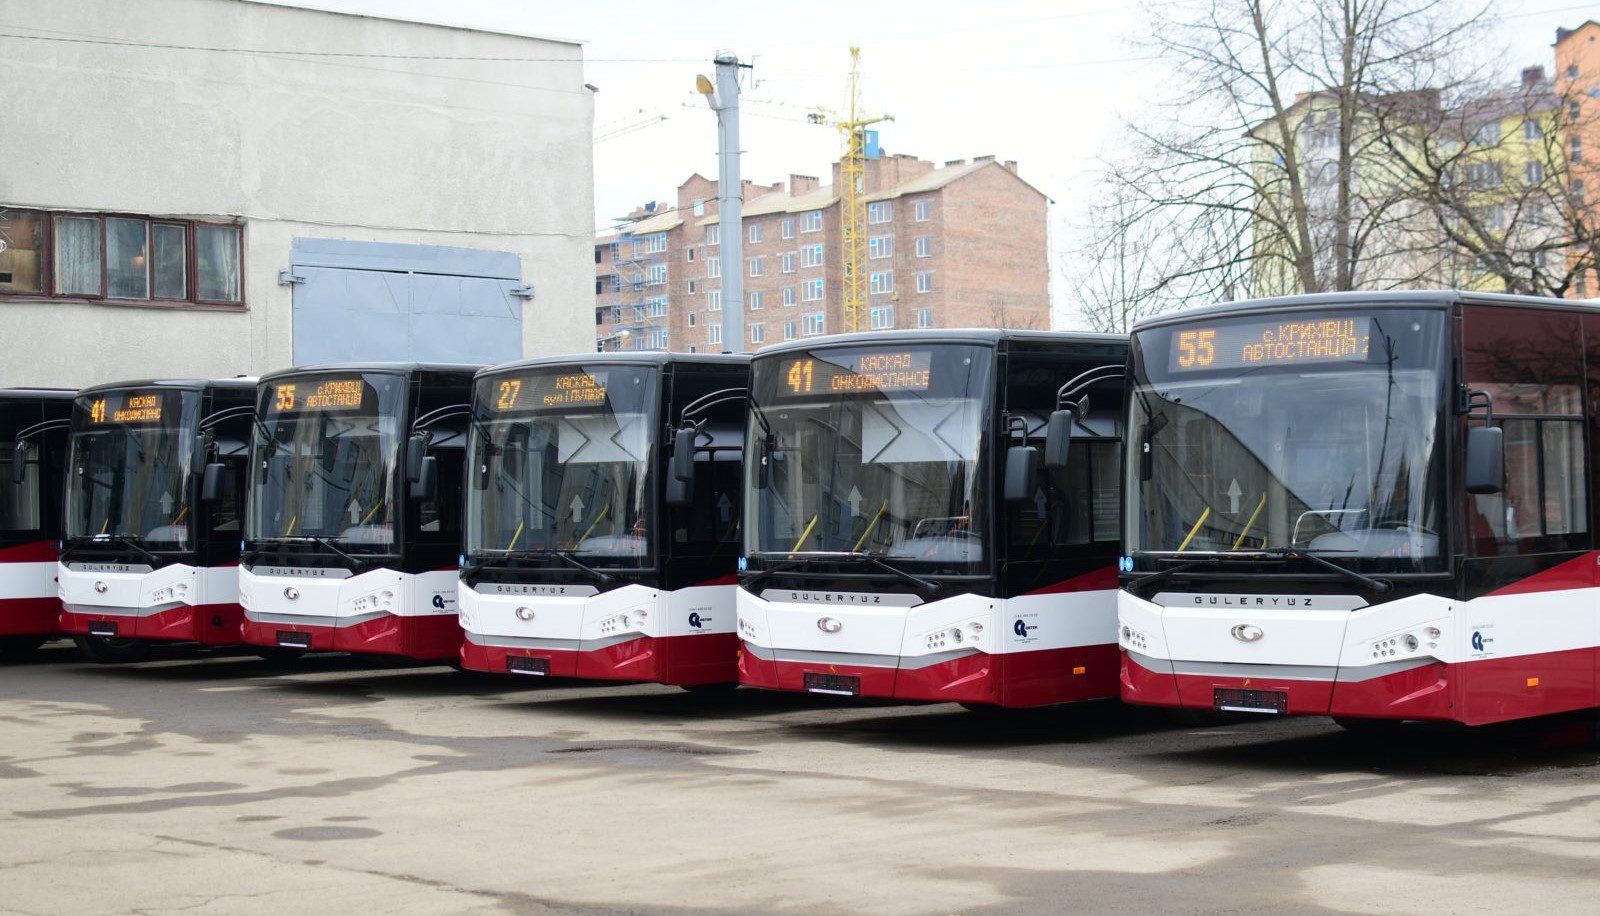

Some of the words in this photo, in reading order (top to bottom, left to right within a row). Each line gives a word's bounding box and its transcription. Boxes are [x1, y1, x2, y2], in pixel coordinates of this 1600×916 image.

[1178, 330, 1217, 367] 55
[788, 360, 814, 392] 41
[860, 354, 911, 371] КАСКАД
[276, 385, 296, 411] 55
[498, 380, 521, 409] 27
[91, 399, 105, 423] 41
